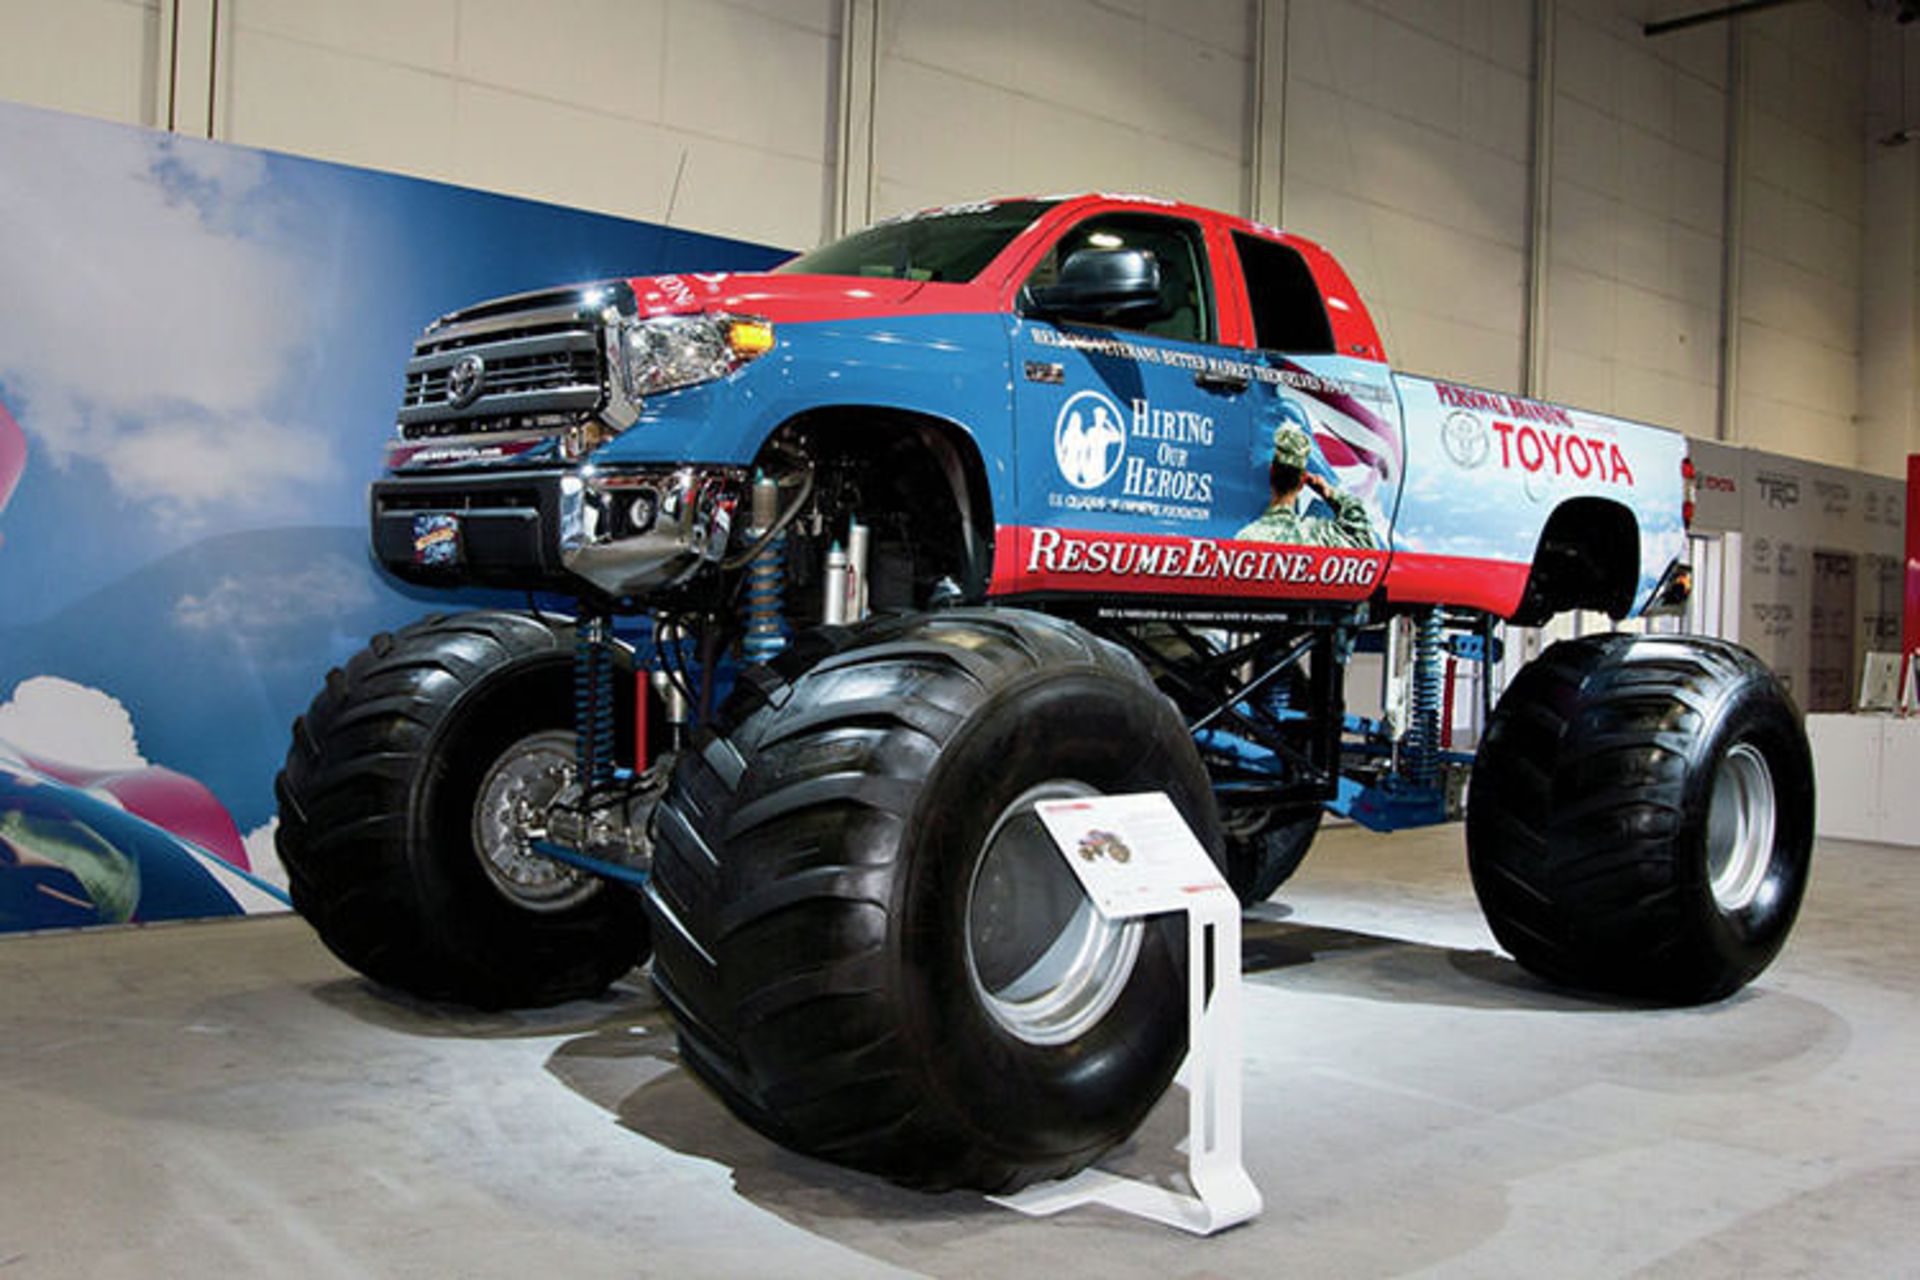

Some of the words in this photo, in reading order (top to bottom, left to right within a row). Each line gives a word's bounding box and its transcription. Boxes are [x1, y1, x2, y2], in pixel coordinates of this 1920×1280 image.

[1131, 398, 1214, 446] HIRING
[1156, 441, 1188, 468] OUR
[1492, 420, 1634, 486] TOYOTA
[1755, 477, 1800, 510] TRD
[1027, 526, 1380, 587] RESUMEENGINE.ORG
